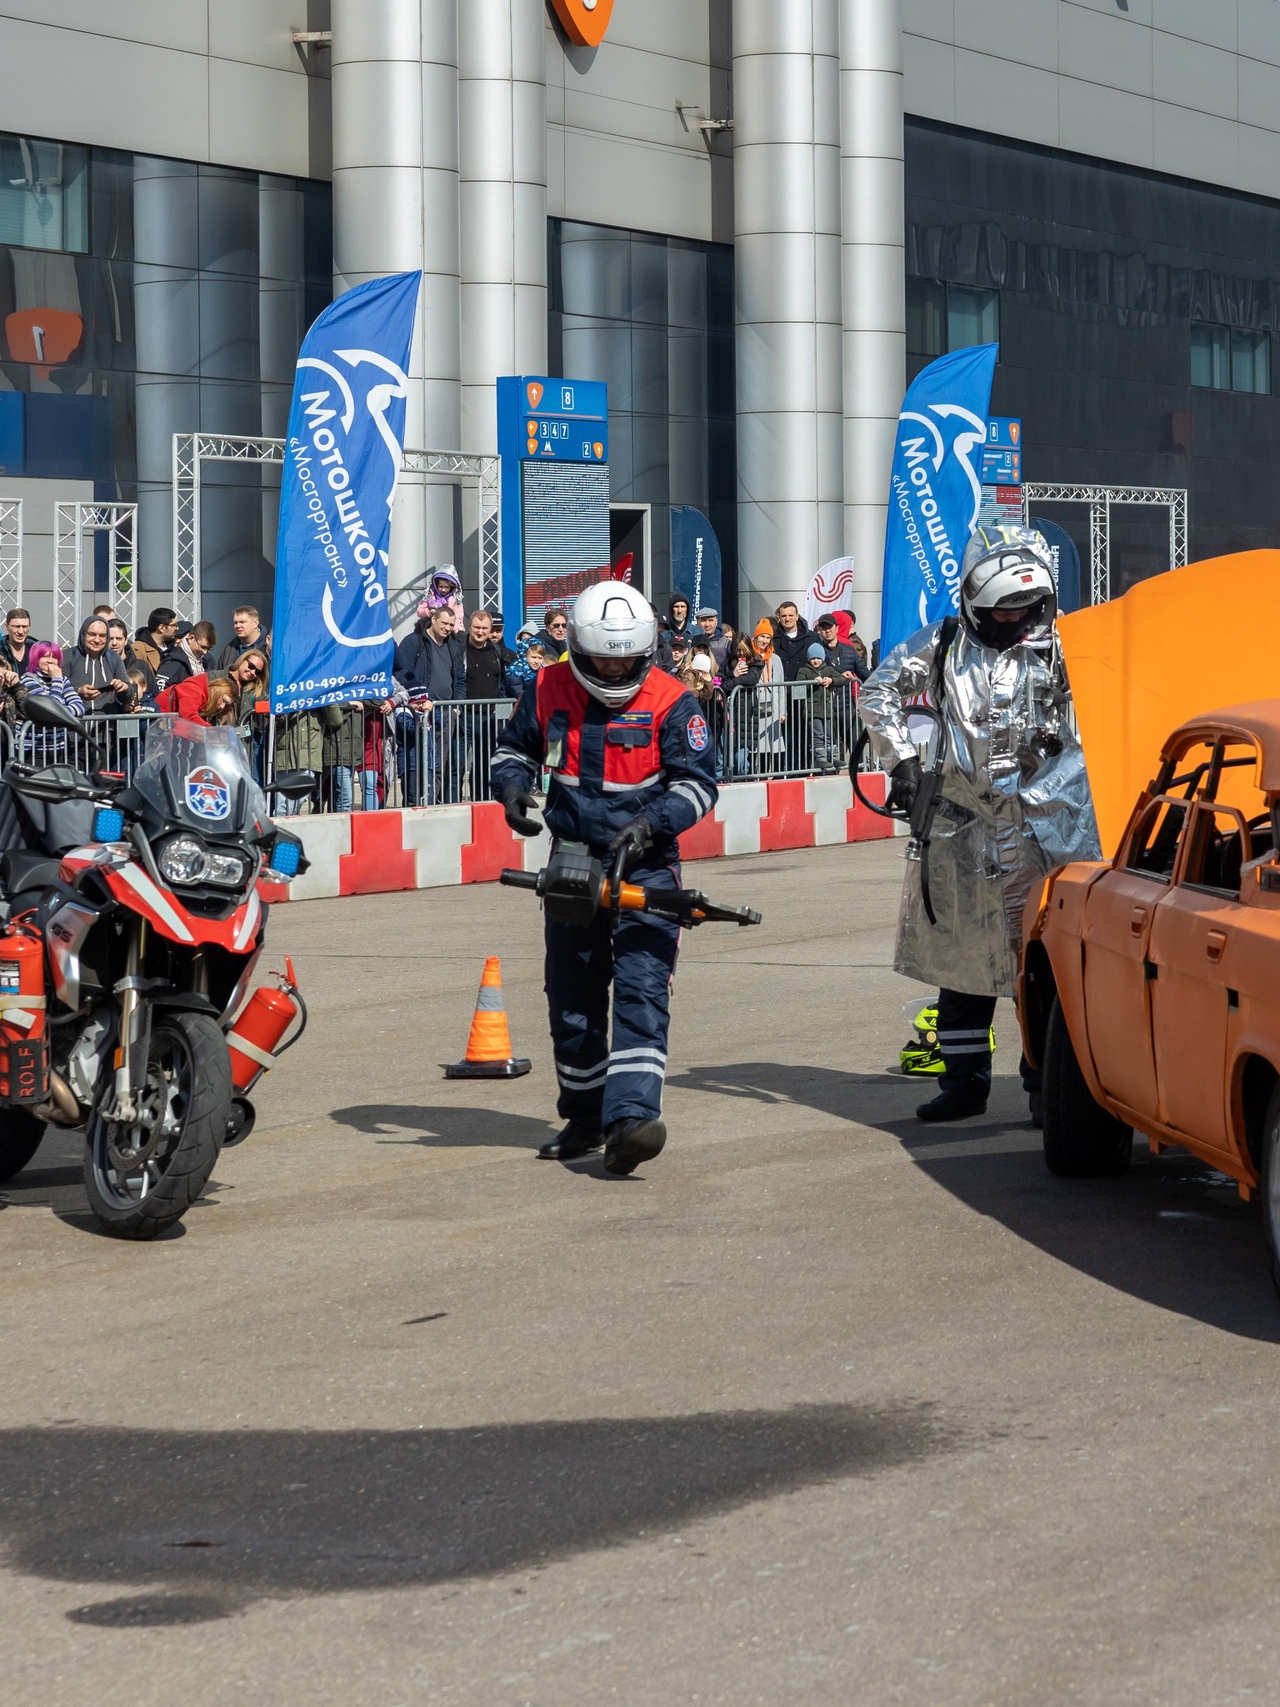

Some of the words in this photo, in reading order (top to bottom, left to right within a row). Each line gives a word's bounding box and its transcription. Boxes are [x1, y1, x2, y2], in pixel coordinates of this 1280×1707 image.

[276, 671, 387, 696] 8-910-499-40-02
[275, 687, 389, 714] 8-499-723-17-18
[51, 922, 73, 943] GS
[18, 1047, 36, 1098] ROLF
